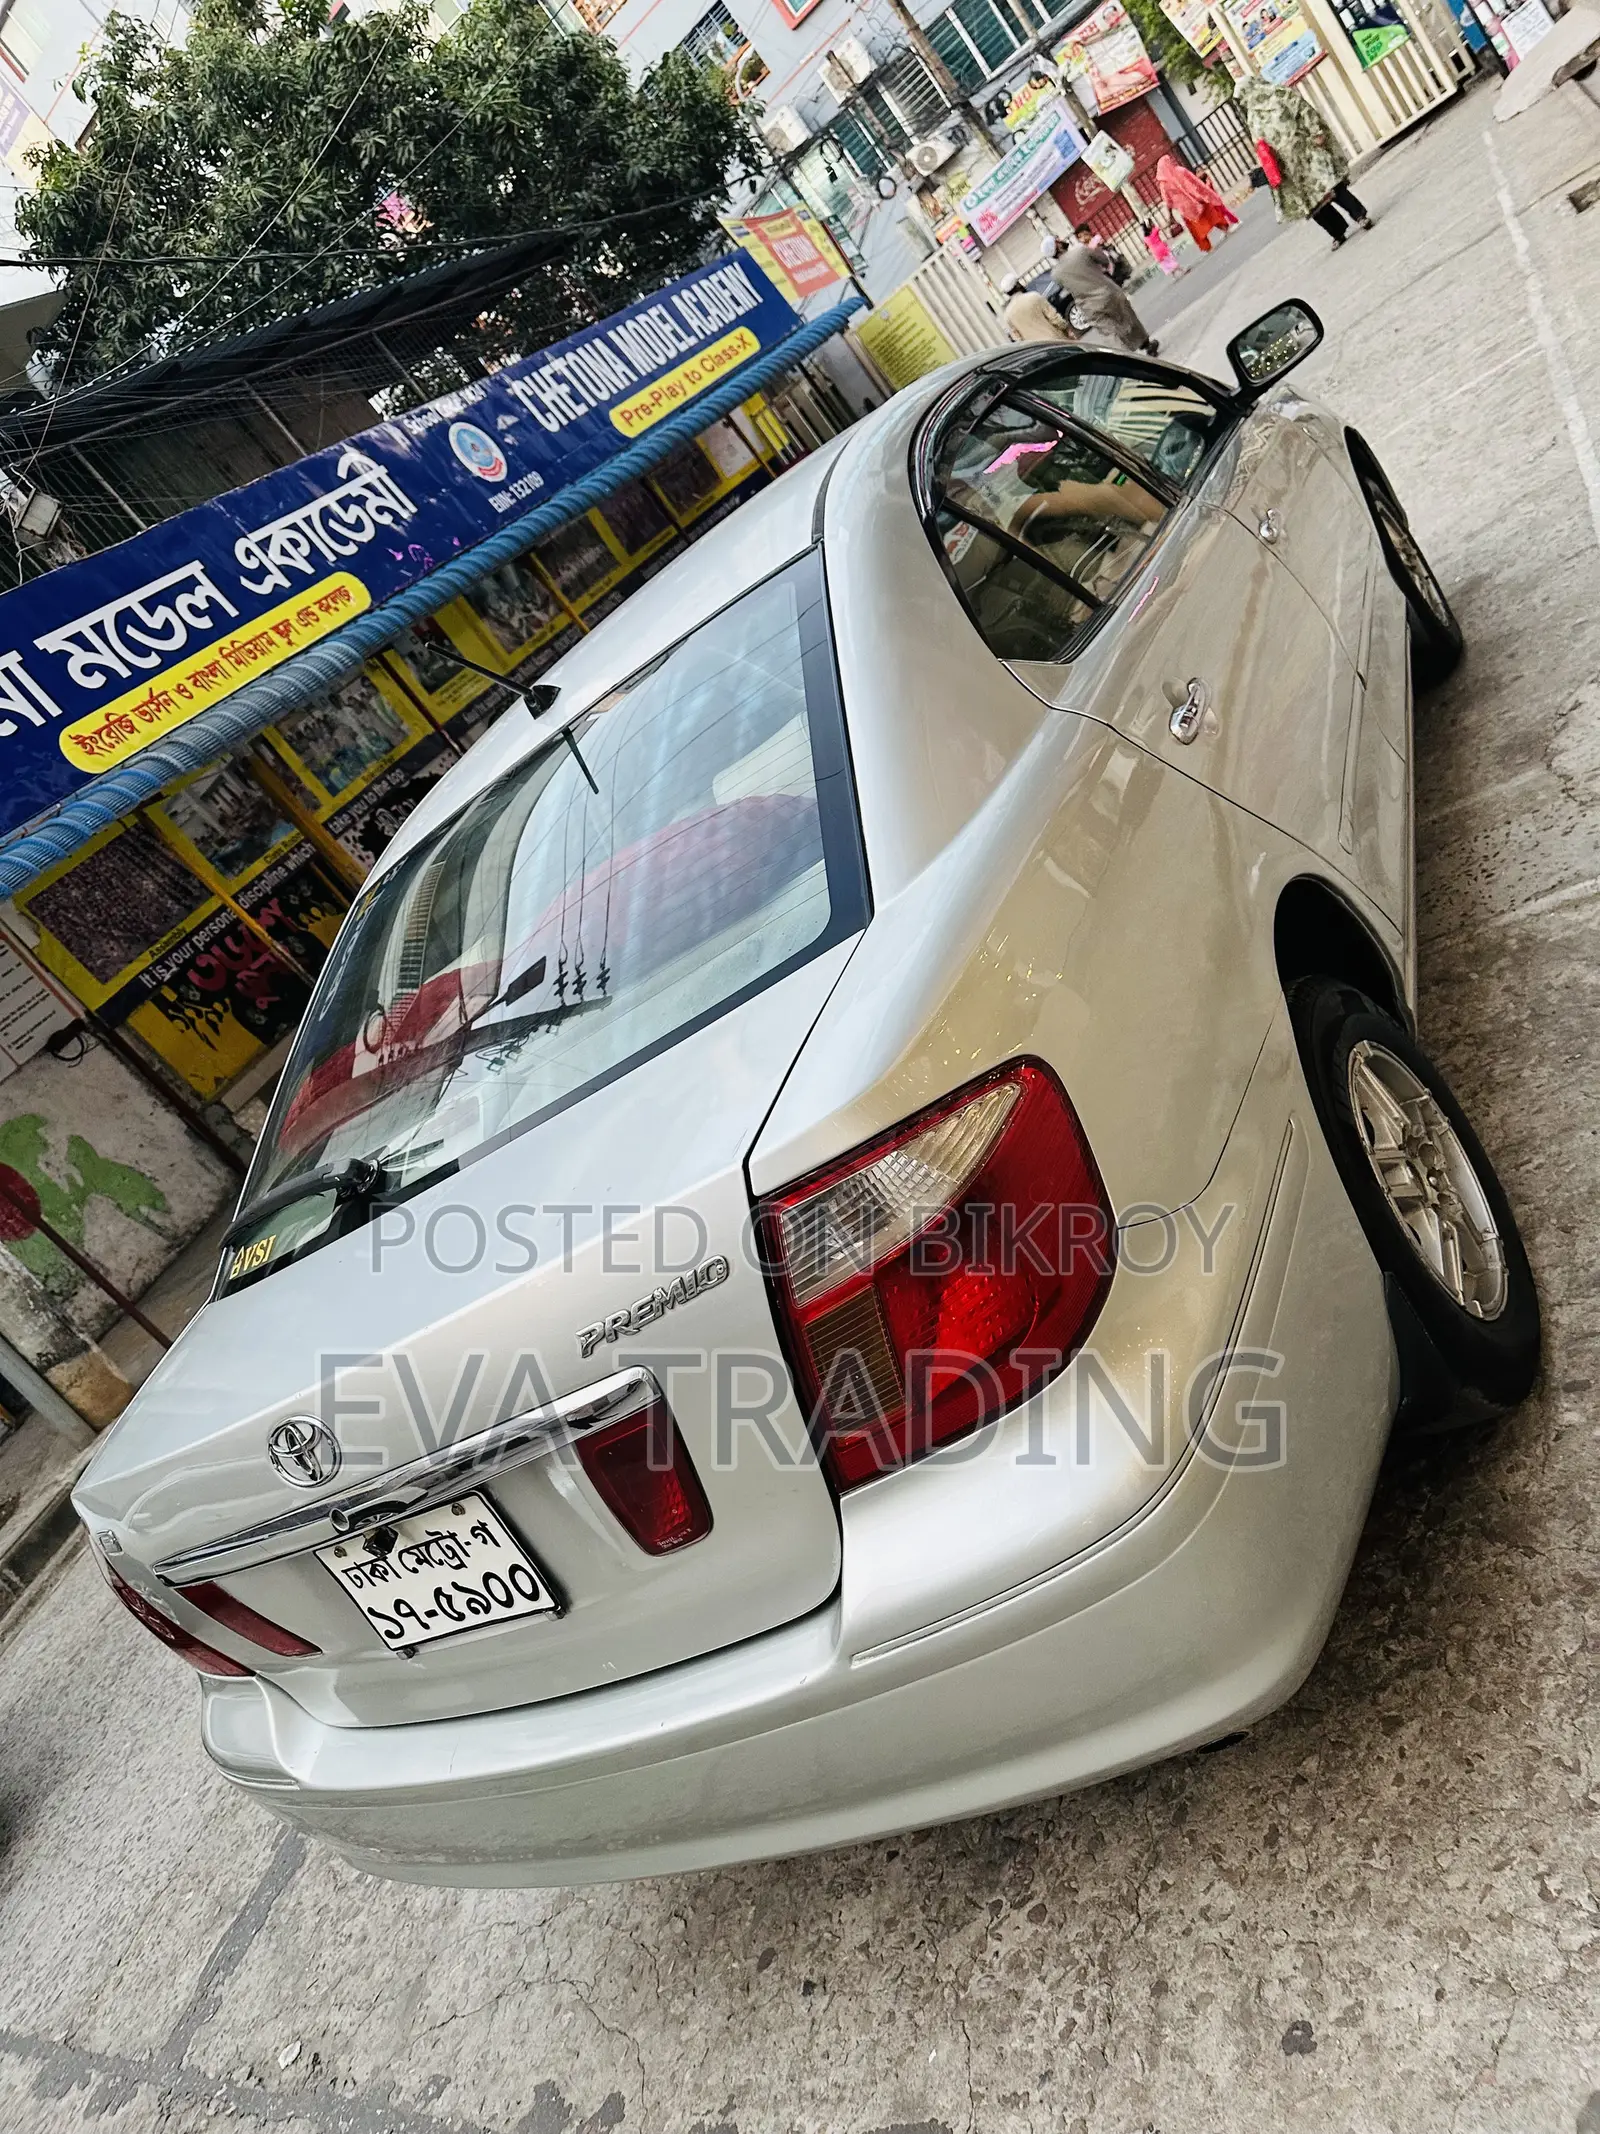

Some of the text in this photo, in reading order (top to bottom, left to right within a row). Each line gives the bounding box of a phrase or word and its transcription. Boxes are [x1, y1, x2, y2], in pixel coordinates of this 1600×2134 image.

[511, 261, 764, 433] CHETONA MODEL ACADEMY
[619, 332, 753, 428] Pre-Play to Class-X
[402, 403, 442, 435] School
[488, 471, 545, 514] EIIN: 132109
[33, 560, 239, 690] মডেল
[234, 446, 418, 595] একাডেমী
[69, 712, 140, 757] ইংরেজি
[131, 687, 180, 722] ভার্সন
[174, 683, 195, 700] ও
[185, 657, 231, 693] বাংলা
[218, 631, 278, 672] মিডিয়াম
[270, 618, 300, 648] স্কুল
[314, 585, 354, 616] কলেজ
[327, 813, 352, 834] take
[348, 799, 369, 821] you
[363, 791, 378, 804] to
[371, 780, 391, 797] the
[386, 768, 410, 788] top
[139, 842, 317, 988] It is your persona discipline which
[575, 1254, 730, 1359] PREMIO
[341, 1519, 501, 1589] ঢাকা মেট্রো-গ
[367, 1563, 540, 1640] ১৭-৫৯০০
